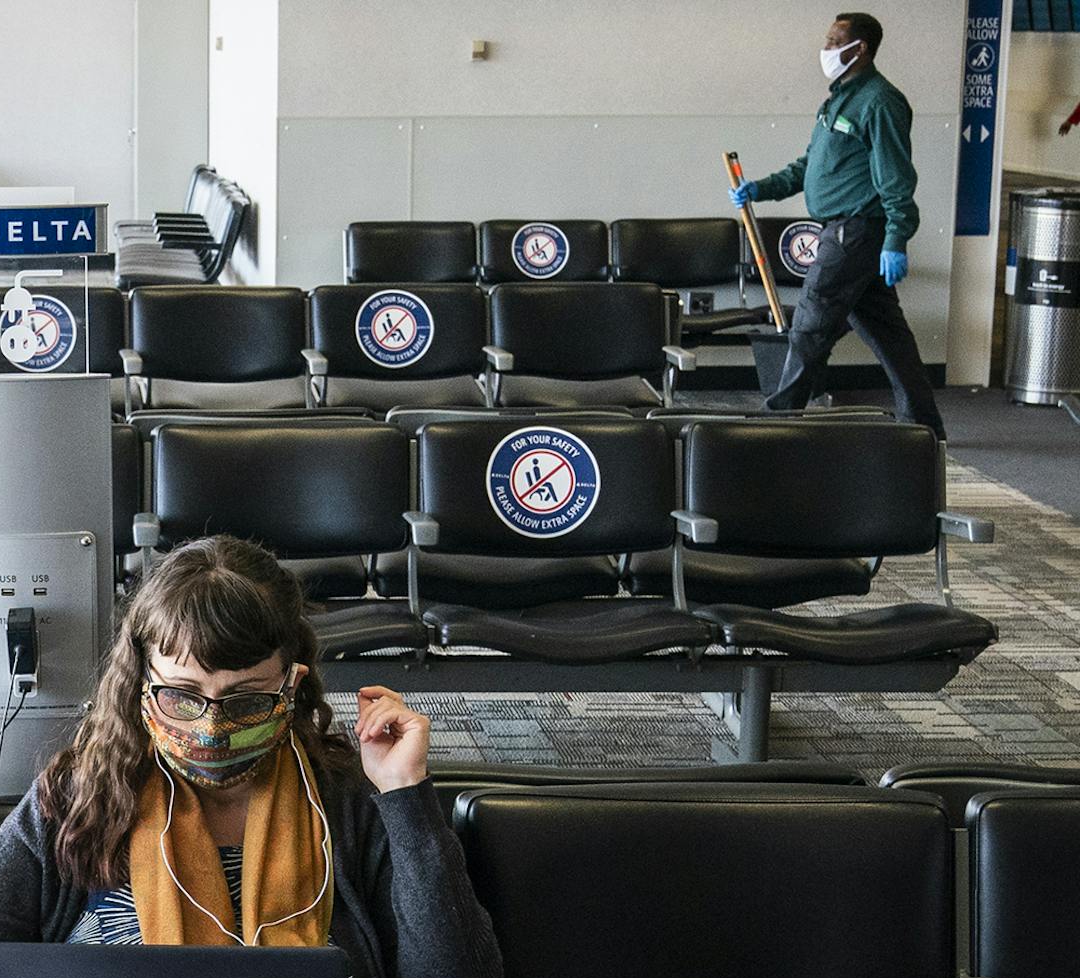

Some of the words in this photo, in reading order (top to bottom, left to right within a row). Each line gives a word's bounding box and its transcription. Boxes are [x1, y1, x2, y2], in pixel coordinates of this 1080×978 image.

[967, 17, 1000, 29] PLEASE
[967, 29, 999, 40] ALLOW
[966, 74, 993, 85] SOME
[964, 86, 994, 97] EXTRA
[963, 97, 992, 108] SPACE
[511, 438, 528, 452] FOR
[527, 435, 551, 444] YOUR
[551, 437, 580, 458] SAFETY
[495, 486, 515, 515] PLEASE
[512, 513, 540, 529] ALLOW
[541, 514, 569, 529] EXTRA
[566, 494, 588, 518] SPACE
[0, 575, 17, 583] USB
[32, 575, 50, 583] USB
[39, 617, 52, 625] AC
